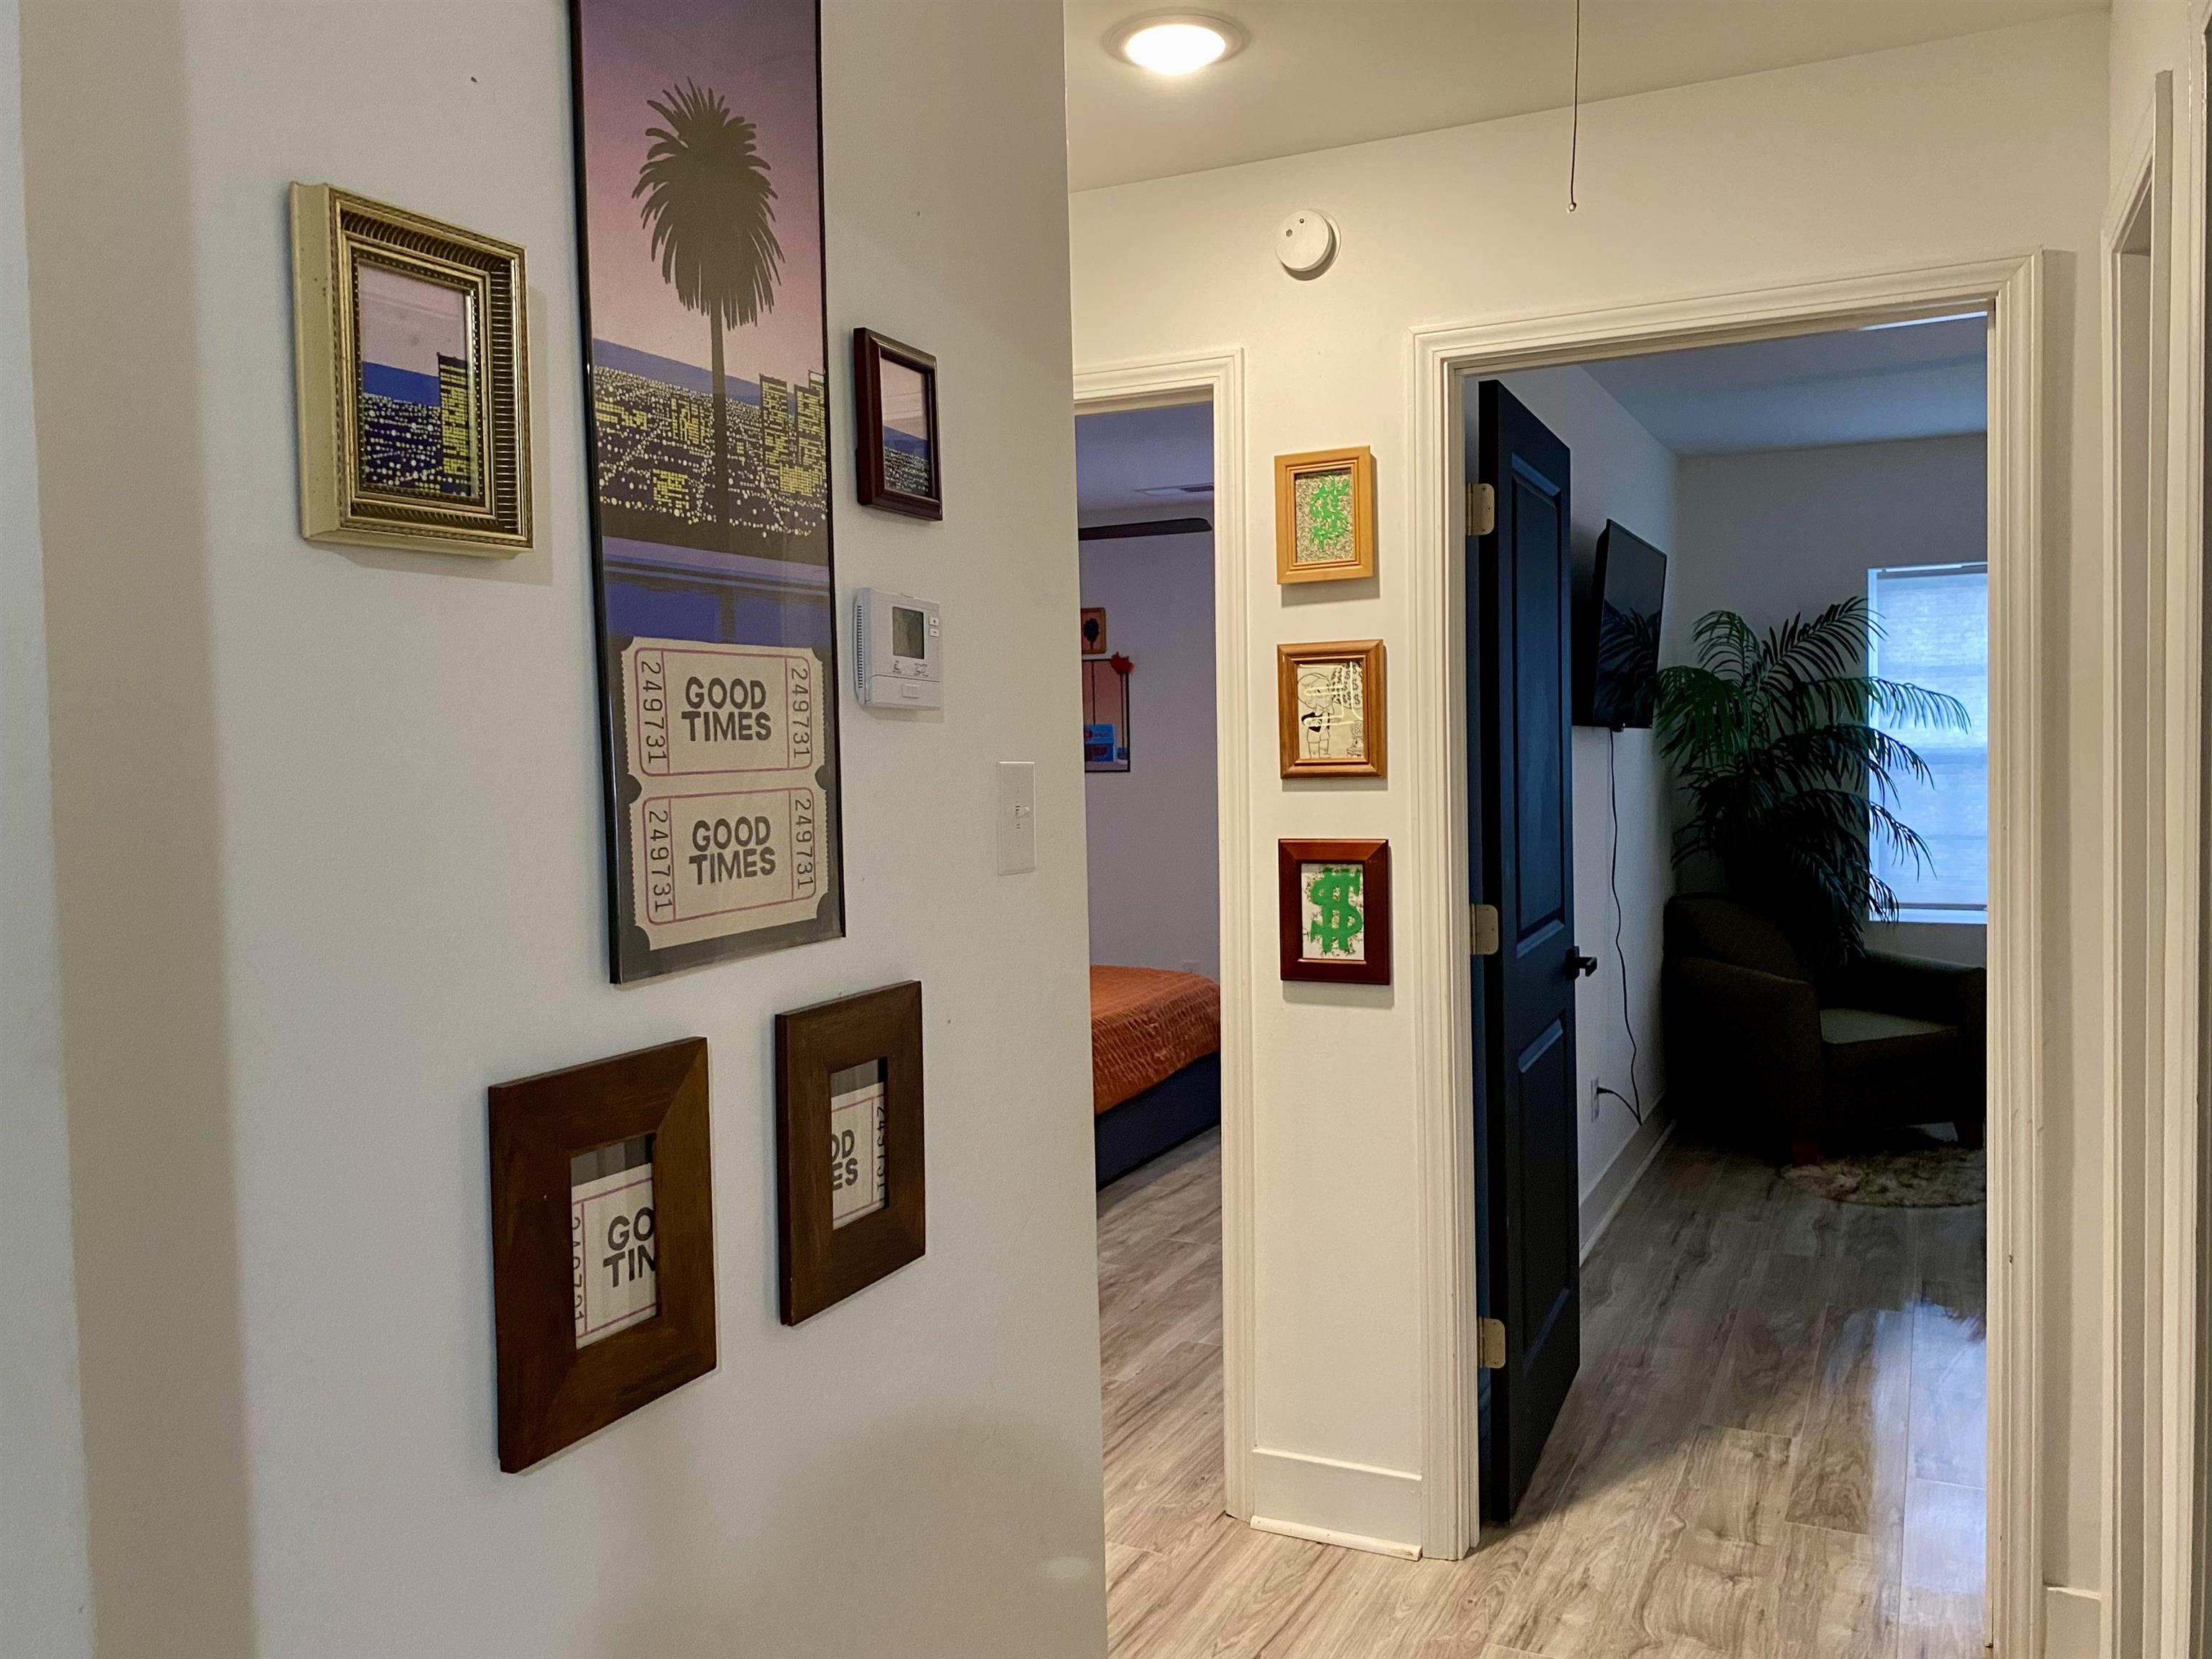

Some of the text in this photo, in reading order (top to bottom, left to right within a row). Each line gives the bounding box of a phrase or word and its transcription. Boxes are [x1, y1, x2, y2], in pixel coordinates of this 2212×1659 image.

[641, 661, 667, 764] 249731
[685, 676, 767, 709] GOOD
[788, 667, 810, 759] 249731
[681, 710, 772, 742] TIMES
[648, 810, 673, 912] 249731
[688, 847, 776, 885] TIMES
[692, 815, 771, 853] GOOD
[794, 798, 814, 889] 249731
